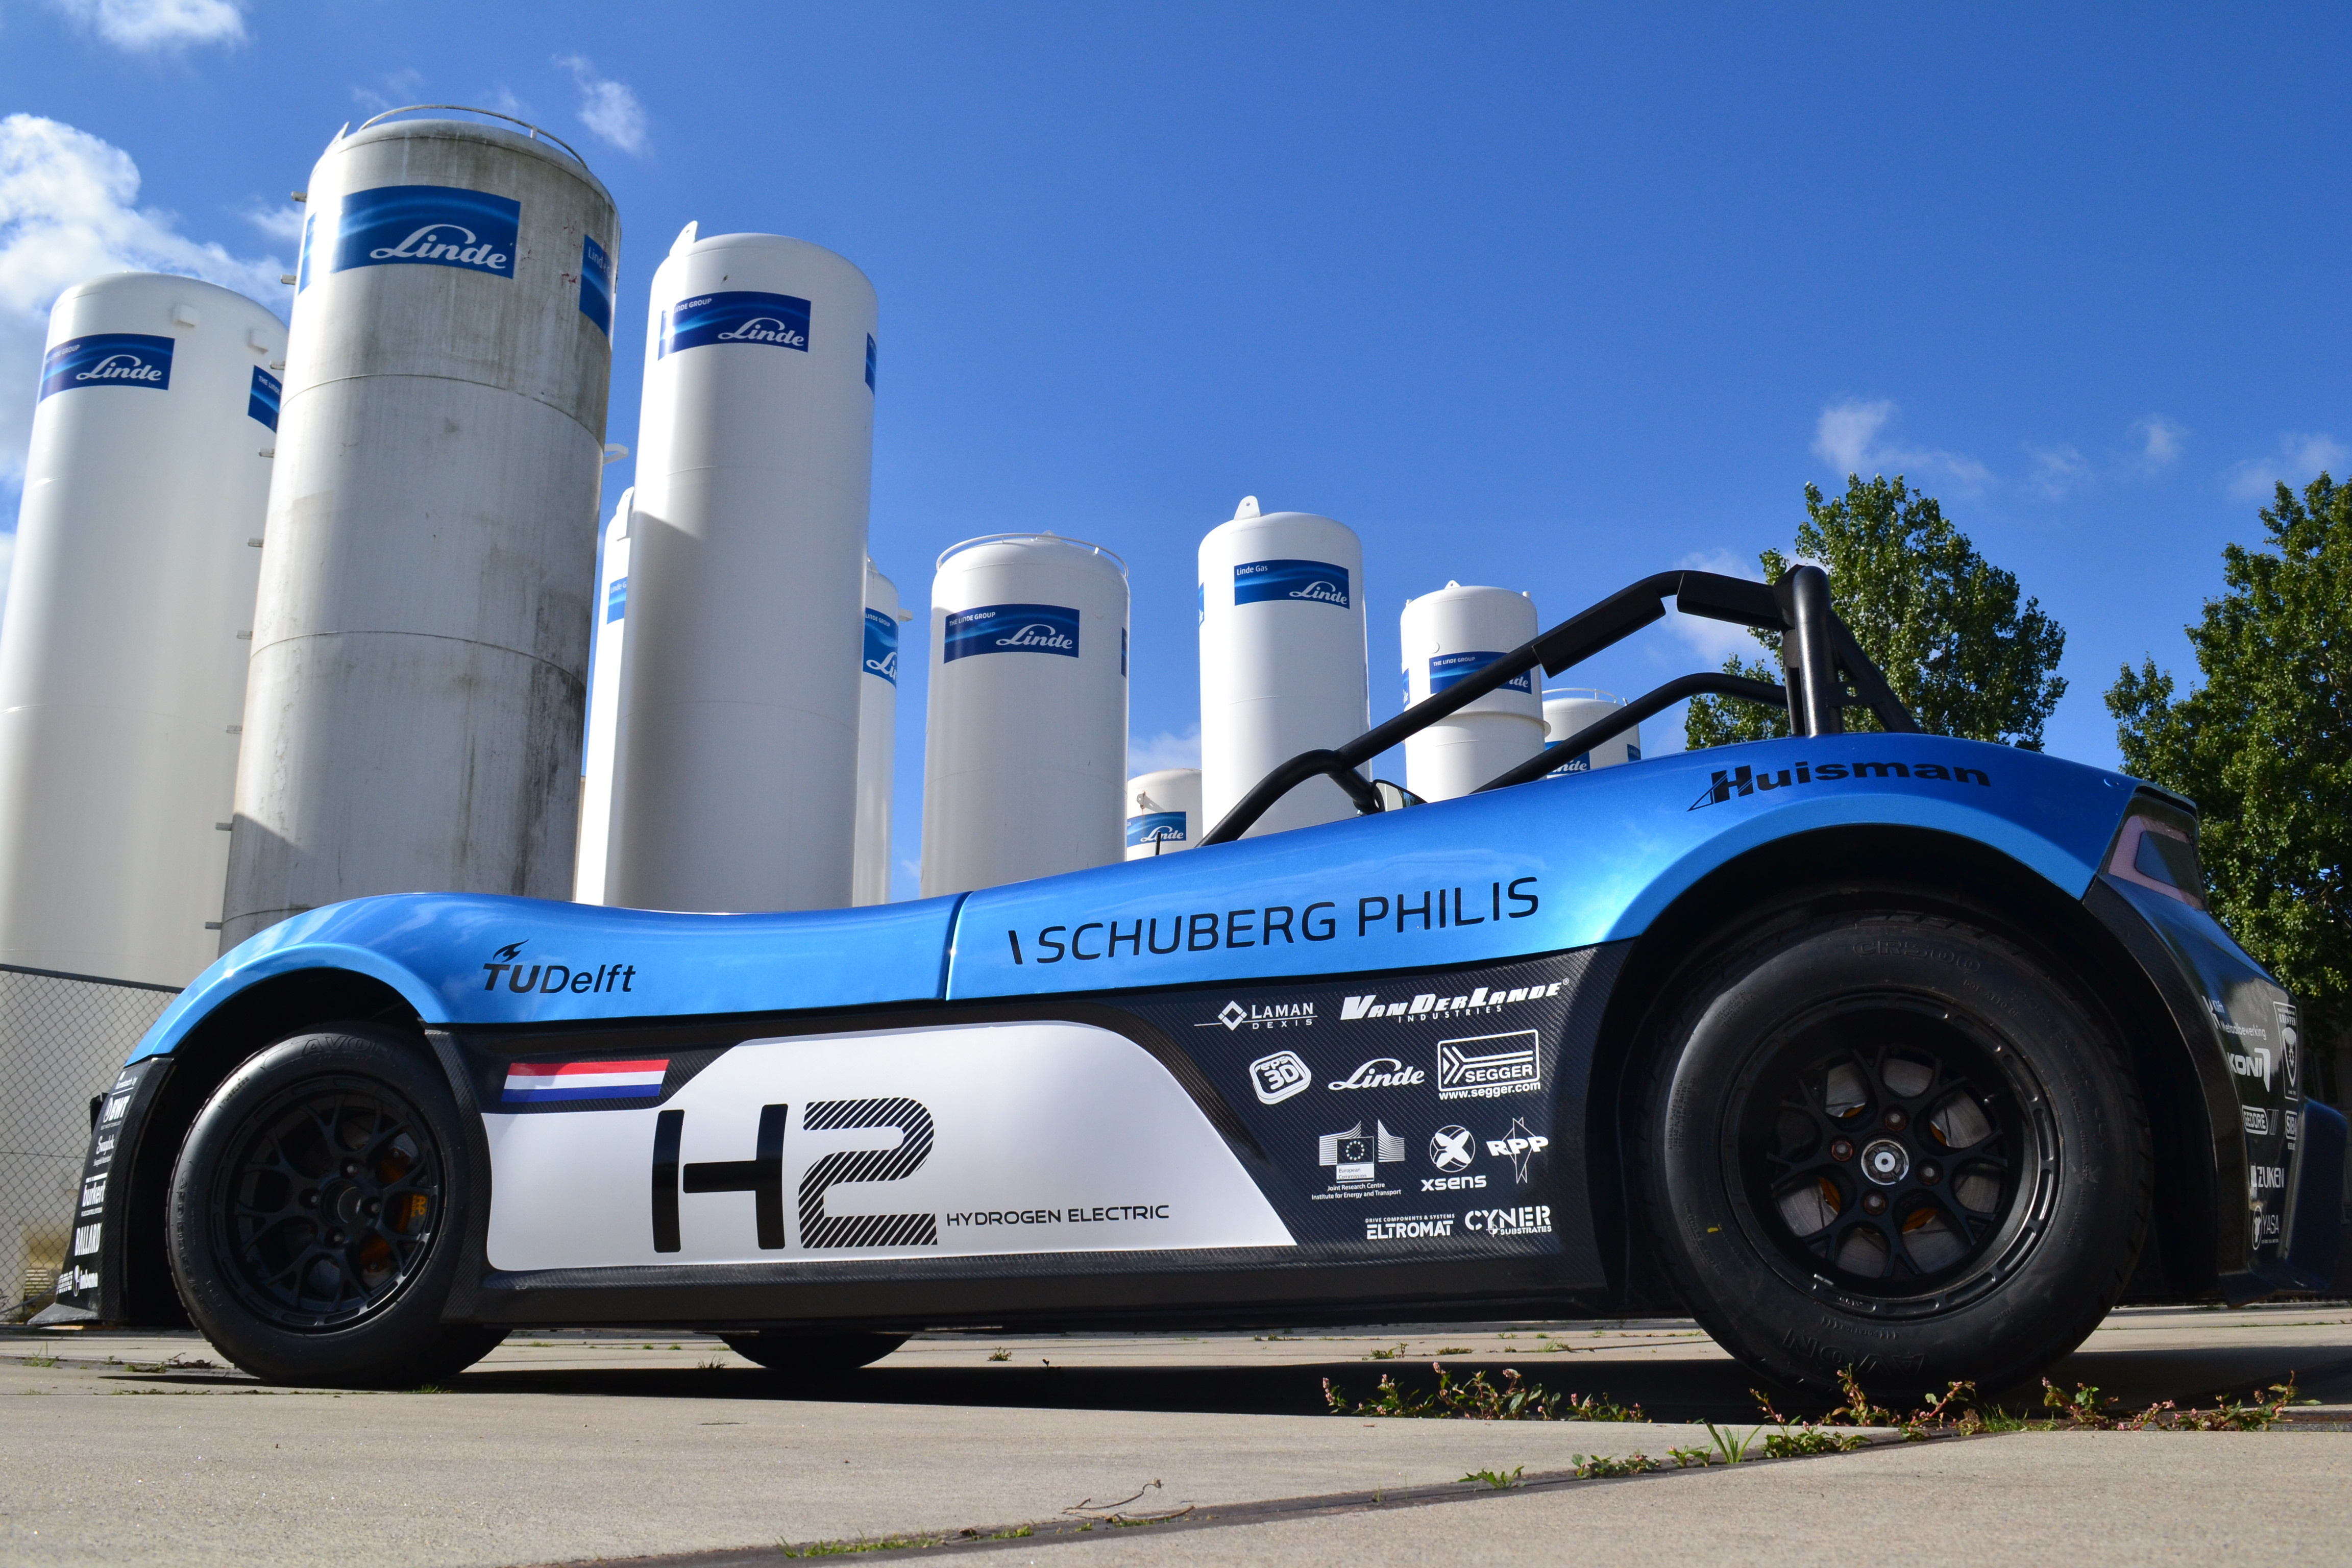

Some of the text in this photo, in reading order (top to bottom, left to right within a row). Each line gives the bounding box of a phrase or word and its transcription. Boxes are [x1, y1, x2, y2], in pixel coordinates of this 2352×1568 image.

[370, 224, 506, 269] Linde
[689, 298, 712, 308] GROUP
[718, 317, 804, 346] Linde
[76, 354, 162, 381] Linde
[1237, 566, 1254, 576] Linde
[1289, 581, 1348, 604] Linde
[958, 615, 973, 624] LINDE
[974, 611, 995, 621] GROUP
[996, 624, 1073, 649] Linde
[1710, 761, 1991, 804] Huisman
[1037, 876, 1538, 964] SCHUBERG PHILIS
[1252, 1002, 1313, 1019] LAMAN
[1399, 1005, 1502, 1023] INDUSTRIES
[1252, 1019, 1313, 1030] DEXIS
[1328, 1058, 1425, 1090] Linde
[1465, 1064, 1533, 1083] SEGGER
[2227, 1051, 2262, 1077] KONI
[1264, 1064, 1299, 1090] 3D
[1439, 1081, 1541, 1100] www.segger.com
[2243, 1111, 2266, 1129] GEDORE
[1486, 1136, 1549, 1157] RPP
[651, 1097, 938, 1253] H2
[1421, 1175, 1487, 1192] xsens
[2257, 1166, 2284, 1188] ZUKEN
[947, 1205, 1169, 1227] HYDROGEN ELECTRIC
[1465, 1206, 1551, 1231] CYNER
[2263, 1214, 2280, 1235] YASA
[74, 1223, 101, 1257] BALLARD
[1367, 1220, 1454, 1240] ELTROMAT
[1500, 1226, 1552, 1236] SUBSTRATES
